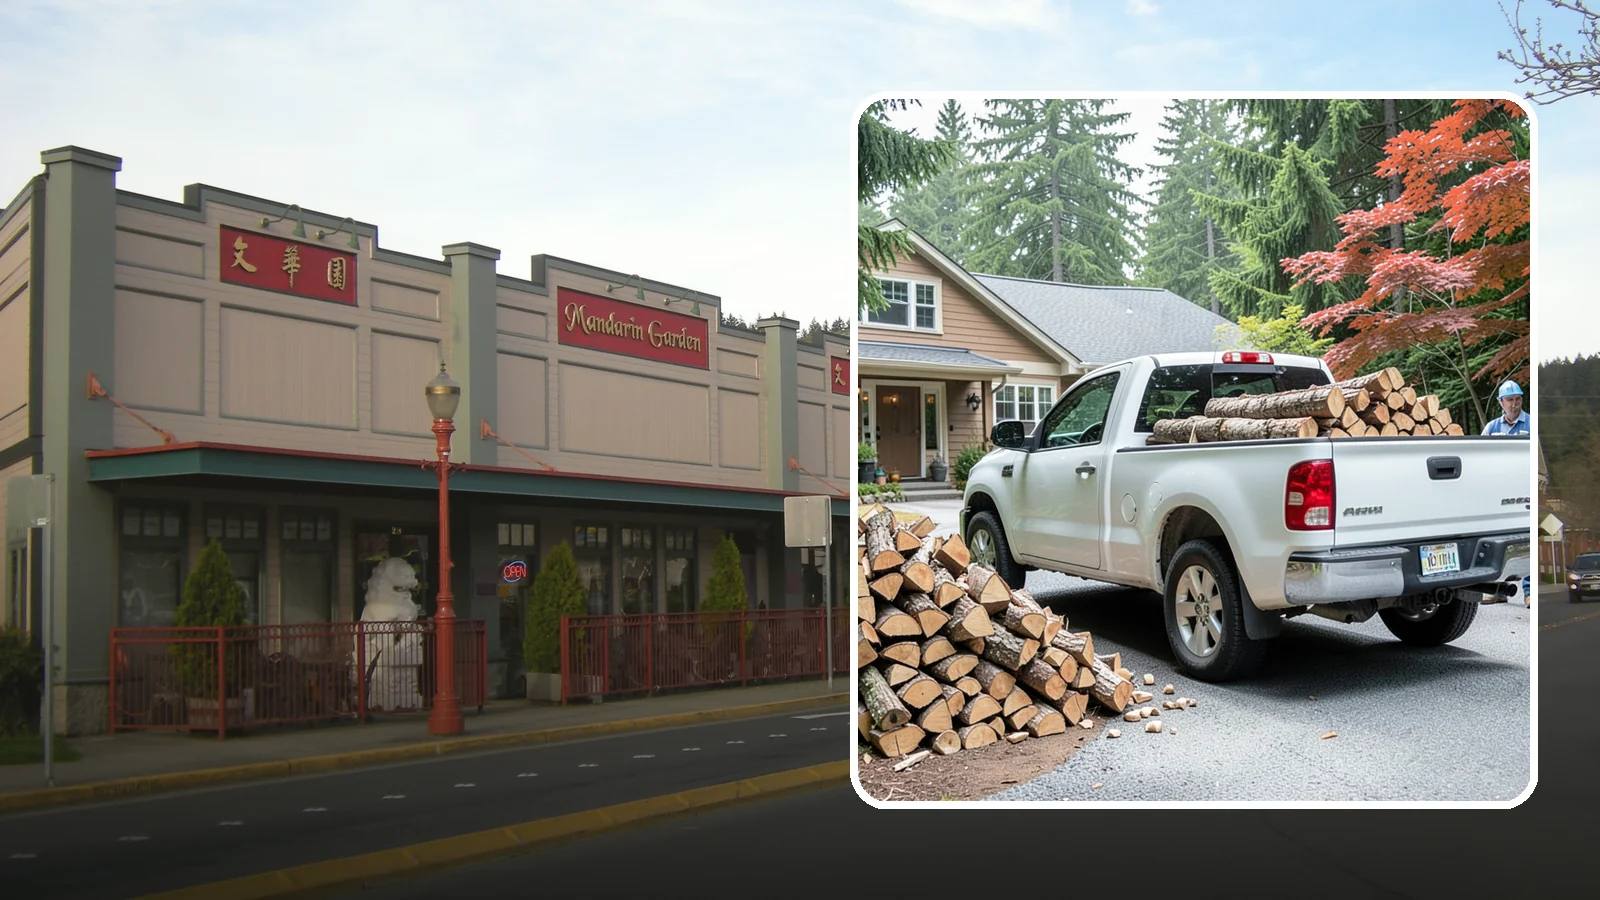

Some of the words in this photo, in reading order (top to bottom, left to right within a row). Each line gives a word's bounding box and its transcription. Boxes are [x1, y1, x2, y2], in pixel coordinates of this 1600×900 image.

[230, 235, 346, 291] 文華園
[564, 302, 644, 341] Mandarin
[648, 320, 701, 352] Garden
[503, 565, 527, 578] OPEN
